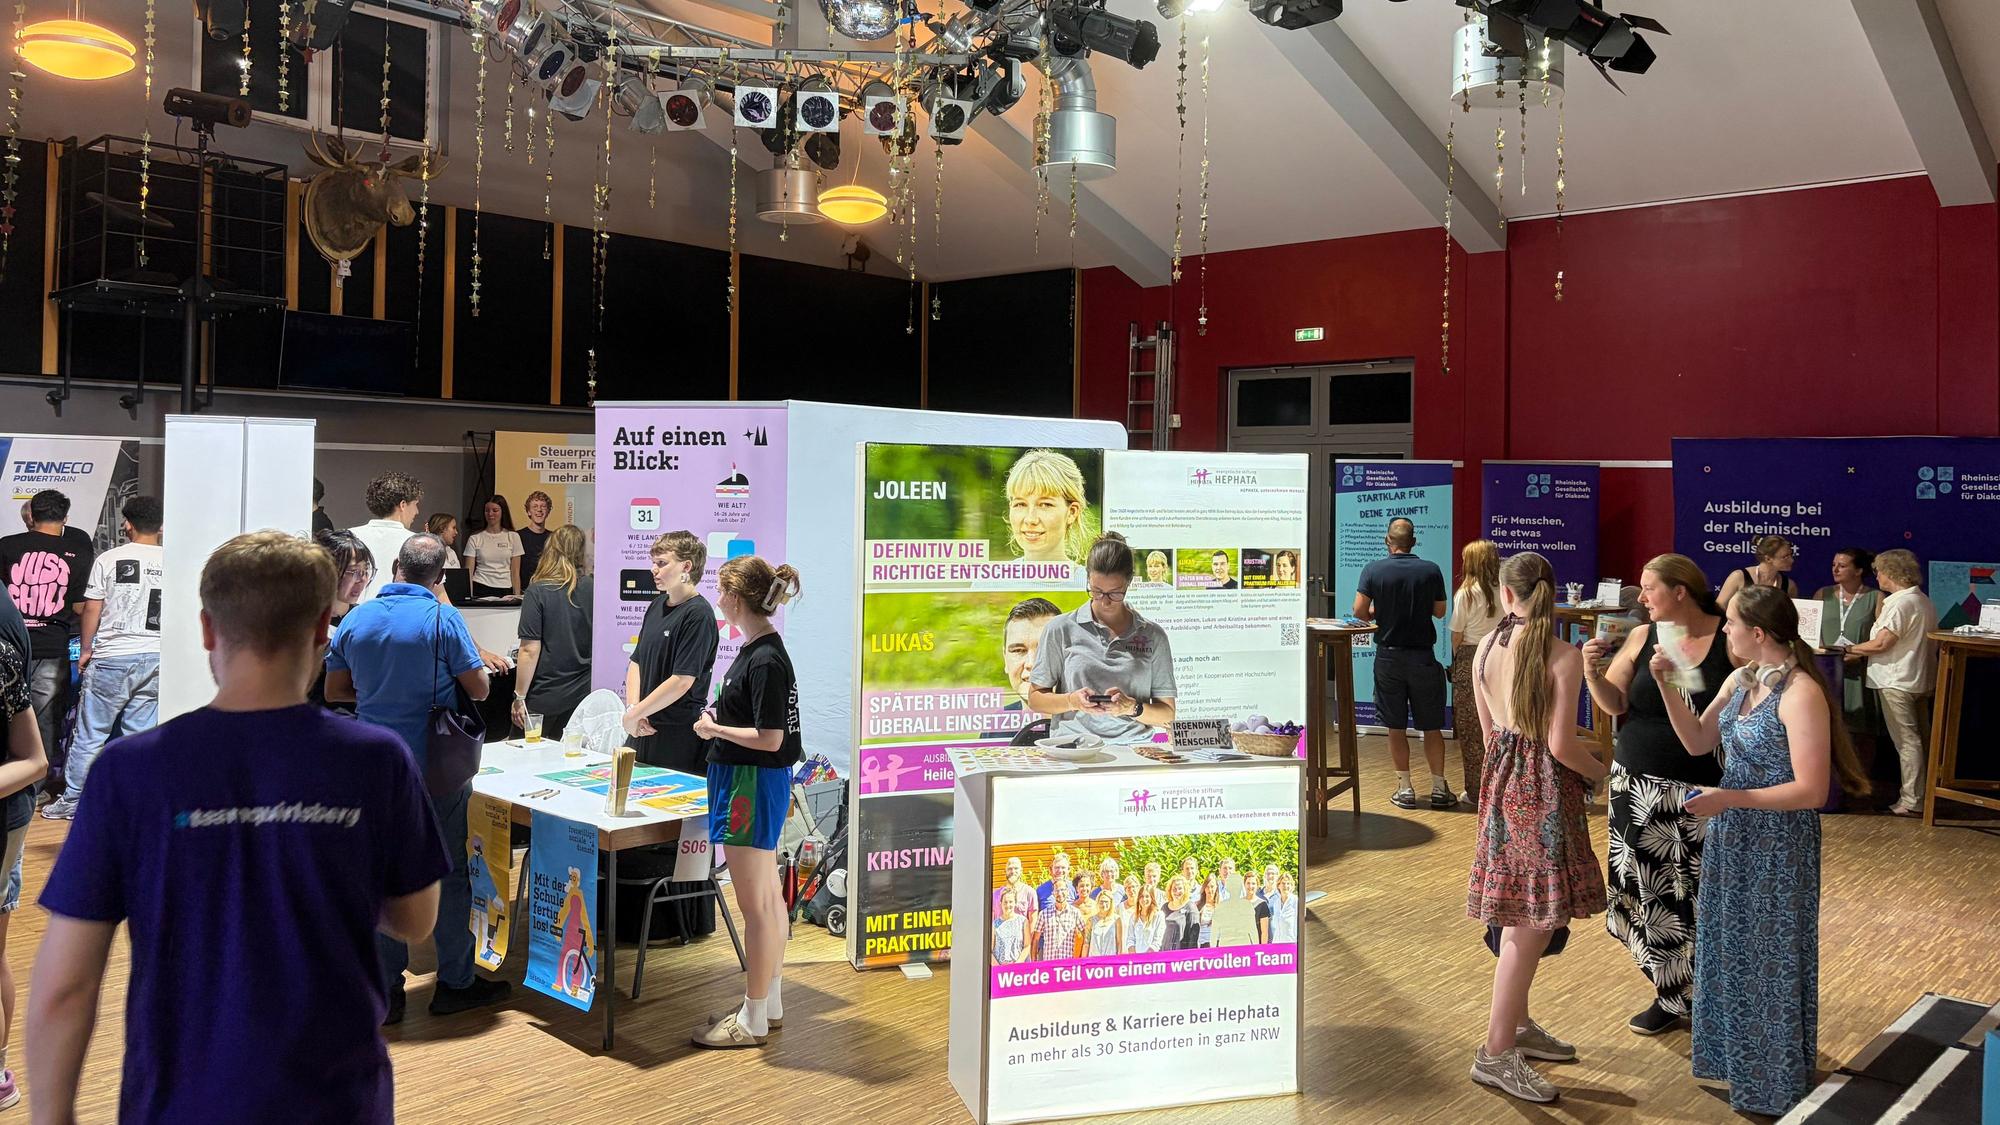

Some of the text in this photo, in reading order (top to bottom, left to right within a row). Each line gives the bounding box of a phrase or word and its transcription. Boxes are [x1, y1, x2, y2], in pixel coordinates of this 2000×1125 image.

[613, 425, 727, 446] Auf einen
[13, 460, 94, 474] TENNECO
[530, 459, 577, 469] im Team
[613, 450, 680, 470] Blick:
[548, 473, 579, 483] mehr
[1215, 475, 1257, 485] HEPHATA
[873, 480, 947, 500] JOLEEN
[1357, 488, 1425, 503] STARTKLAR FÜR
[637, 510, 653, 522] 31
[1359, 506, 1428, 518] DEINE ZUKUNFT?
[1703, 501, 1822, 517] Ausbildung bei
[1491, 515, 1565, 527] Für Menschen,
[1703, 520, 1831, 537] der Rheinischen
[1491, 528, 1541, 538] die etwas
[873, 542, 984, 558] DEFINITIV DIE
[1541, 541, 1576, 551] wollen
[11, 551, 71, 586] JUST
[872, 563, 1070, 580] RICHTIGE ENTSCHEIDUNG
[8, 583, 67, 617] CHILL
[871, 632, 935, 653] LUKAS
[869, 692, 1001, 713] SPÄTER BIN ICH
[869, 715, 942, 736] ÜBERALL
[1172, 720, 1222, 730] IRGENDWAS
[1174, 730, 1188, 738] MIT
[1175, 737, 1221, 747] MENSCHEN
[1161, 796, 1224, 810] HEPHATA
[681, 839, 707, 855] S06
[534, 872, 567, 893] Mit der
[533, 887, 565, 908] Schule
[533, 901, 561, 924] fertig,
[532, 917, 549, 932] los!
[866, 912, 899, 933] MIT
[865, 930, 952, 956] PRAKTIKU
[997, 950, 1293, 989] Werde Teil von einem wertvollen Team
[1008, 1004, 1280, 1043] Ausbildung & Karriere bei Hephata
[1008, 1026, 1280, 1066] an mehr als 30 Standorten in ganz NRW
